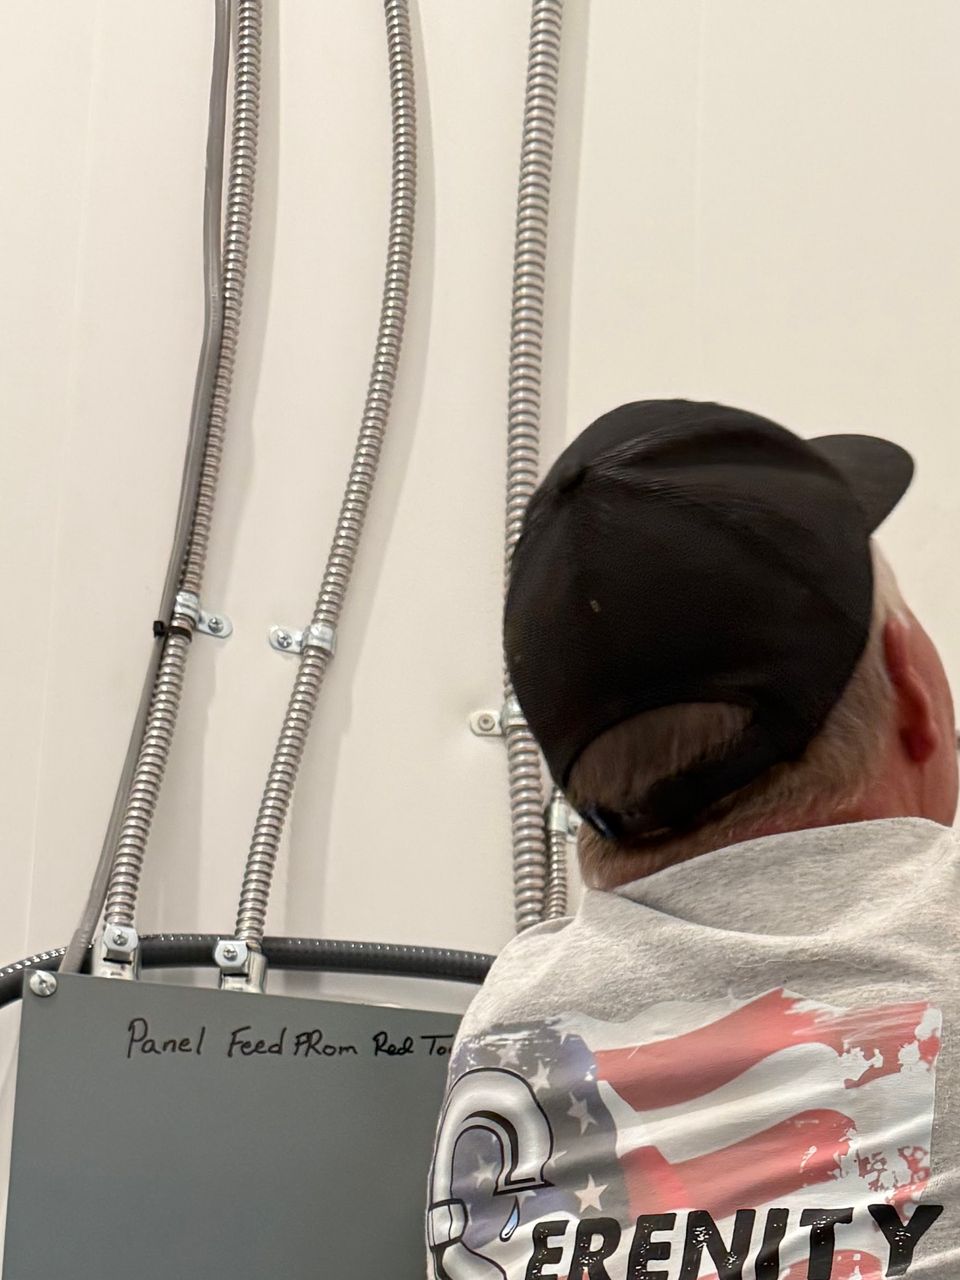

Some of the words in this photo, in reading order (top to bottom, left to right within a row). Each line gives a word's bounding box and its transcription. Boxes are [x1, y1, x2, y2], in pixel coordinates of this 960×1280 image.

[127, 1018, 206, 1059] Panel
[227, 1025, 288, 1058] Feed
[371, 1031, 415, 1056] Red
[421, 1034, 452, 1056] To
